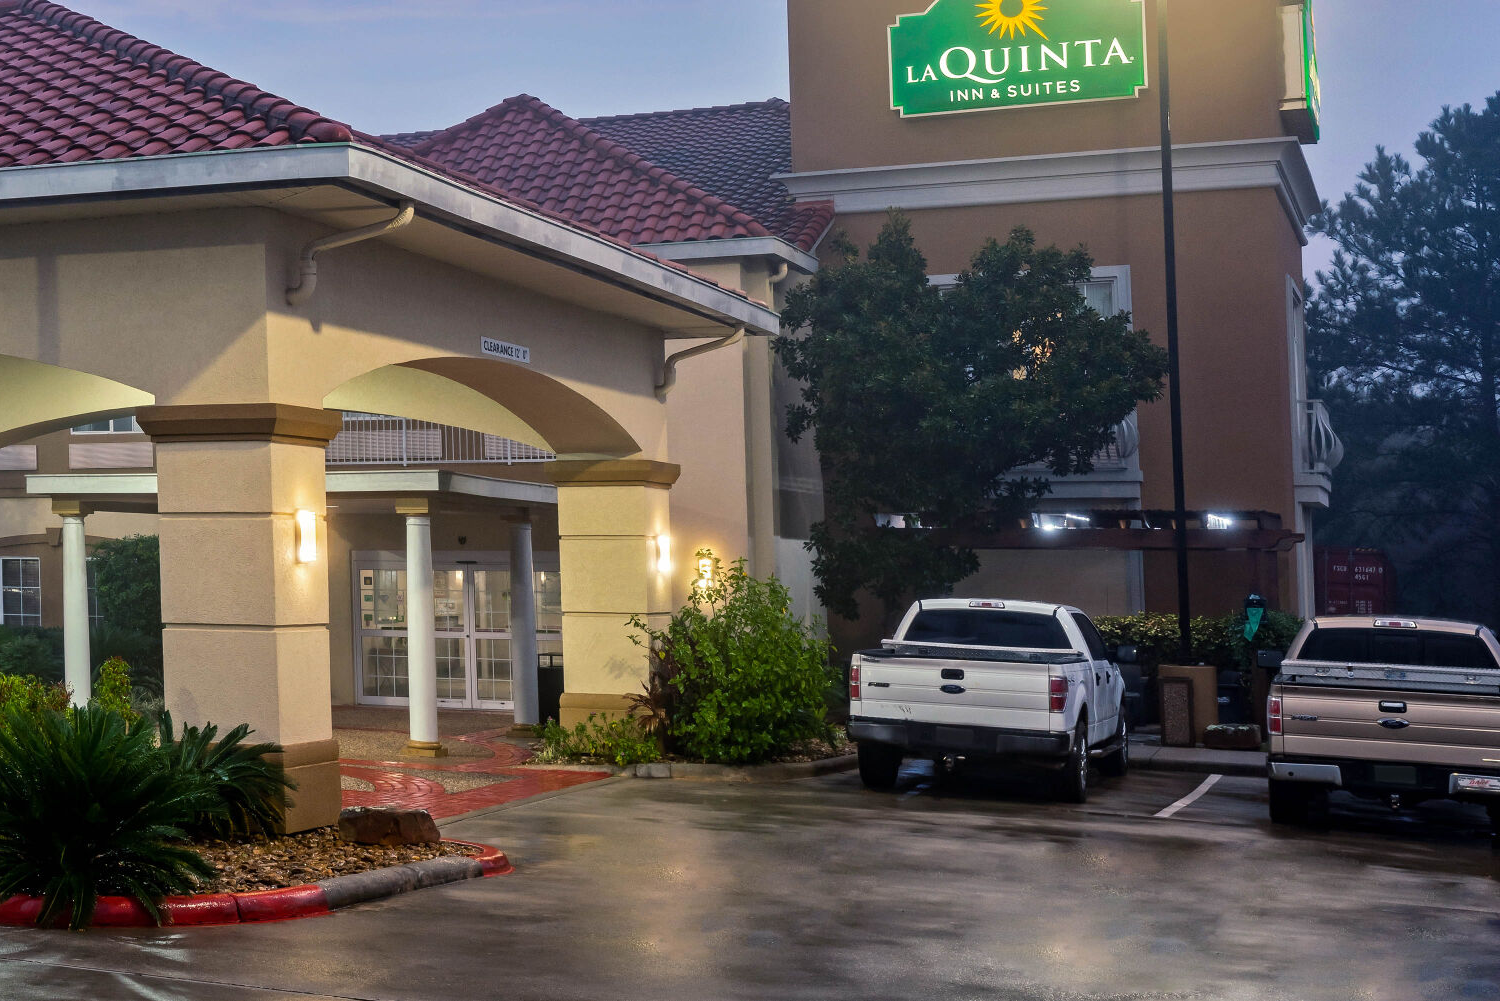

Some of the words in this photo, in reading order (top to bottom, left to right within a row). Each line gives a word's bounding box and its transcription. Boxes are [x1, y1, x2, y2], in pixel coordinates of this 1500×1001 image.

[906, 64, 939, 83] LA
[939, 37, 1133, 84] QUINTA
[950, 88, 984, 102] INN
[990, 88, 1000, 99] &
[1007, 80, 1081, 98] SUITES
[483, 340, 514, 357] CLEARANCE
